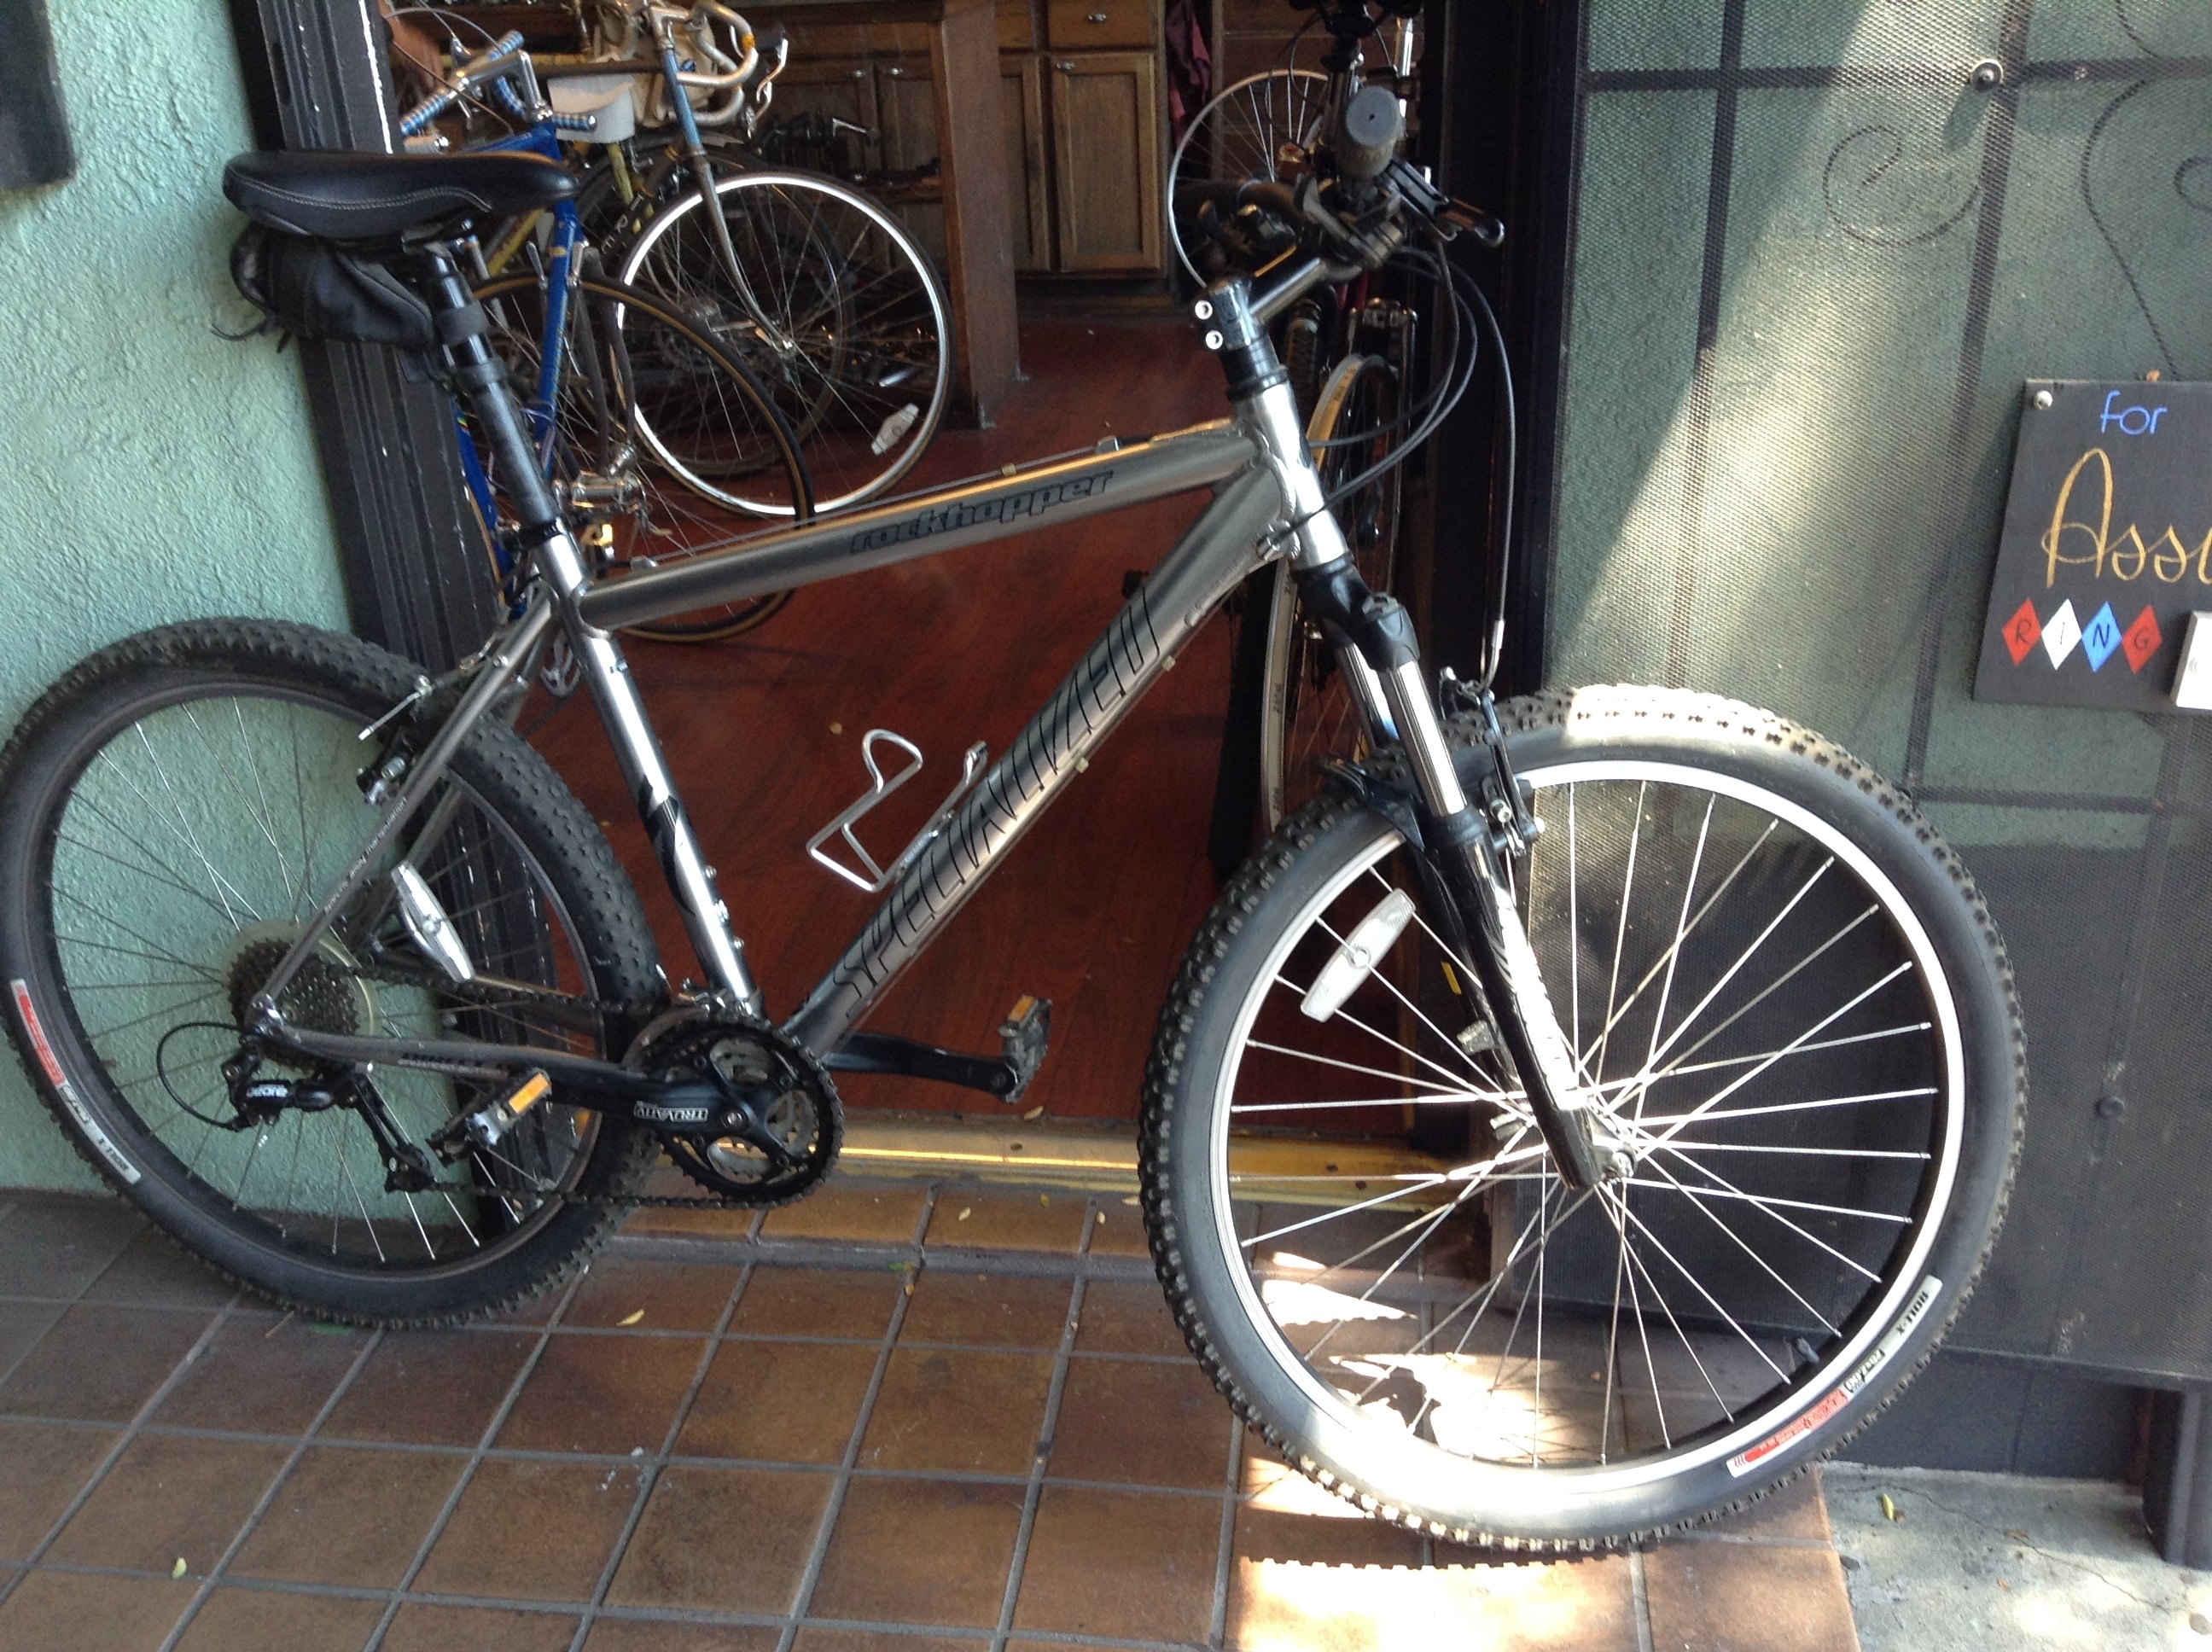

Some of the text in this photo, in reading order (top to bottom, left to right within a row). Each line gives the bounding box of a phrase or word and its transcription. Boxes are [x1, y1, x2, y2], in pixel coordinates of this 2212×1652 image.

[601, 193, 644, 255] TRE
[2100, 390, 2168, 434] for
[850, 470, 1114, 555] rockhopper
[2015, 620, 2150, 649] RING
[833, 586, 1160, 1018] SPECIALIZED
[633, 1100, 708, 1123] TRUVATIV
